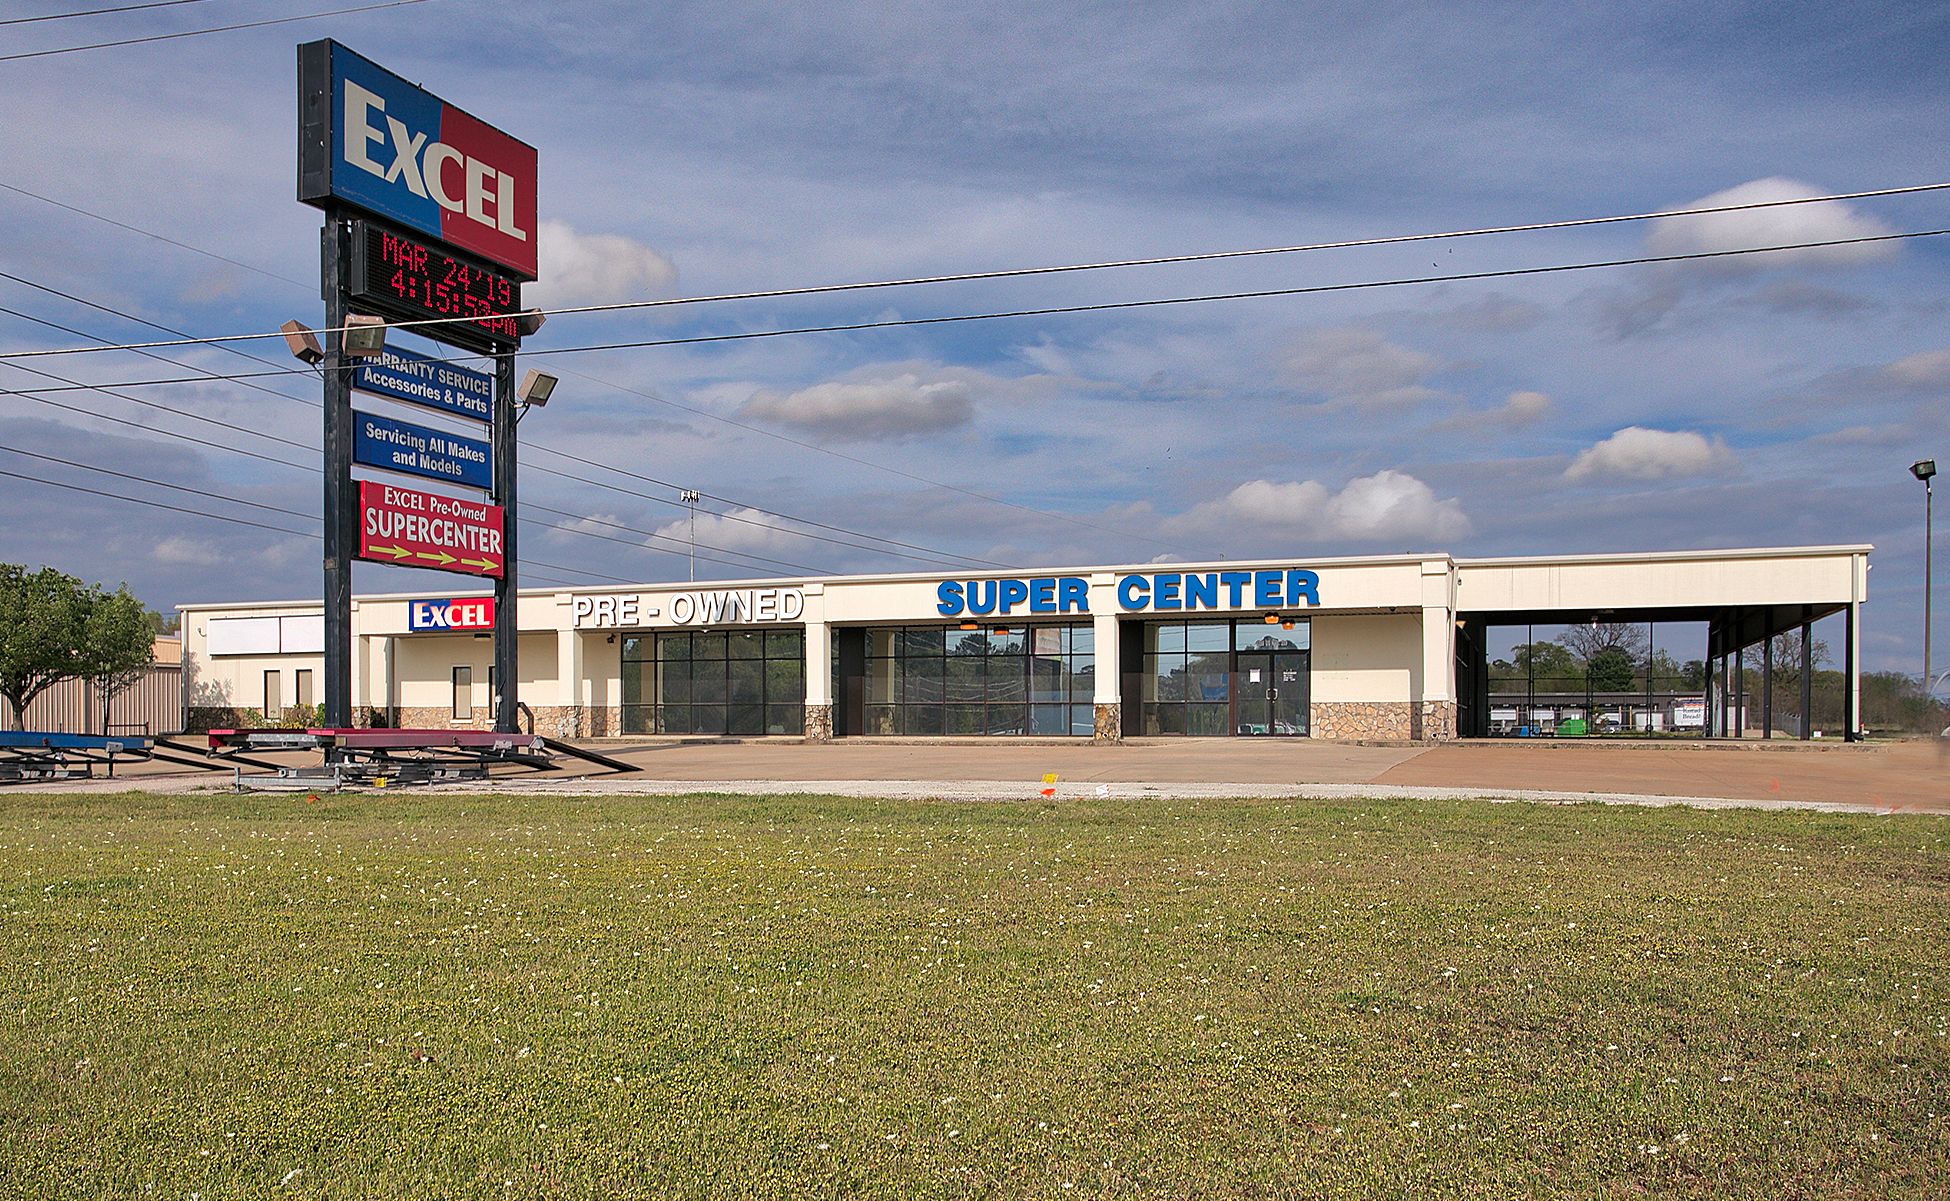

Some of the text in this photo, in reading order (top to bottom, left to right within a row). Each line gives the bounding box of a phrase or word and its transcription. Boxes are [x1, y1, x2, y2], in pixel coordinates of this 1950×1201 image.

[344, 77, 527, 242] EXCEL
[383, 232, 428, 276] MAR
[363, 366, 488, 414] Accessories & Parts
[438, 368, 490, 396] SERVICE
[365, 421, 486, 464] Servicing All Makes
[392, 451, 463, 476] and Models
[384, 486, 487, 522] EXCEL Pre-Owned
[366, 507, 503, 555] SUPERCENTER
[572, 594, 640, 627] PRE
[668, 587, 805, 626] OWNED
[936, 569, 1321, 617] SUPER CENTER
[412, 602, 491, 628] EXCEL
